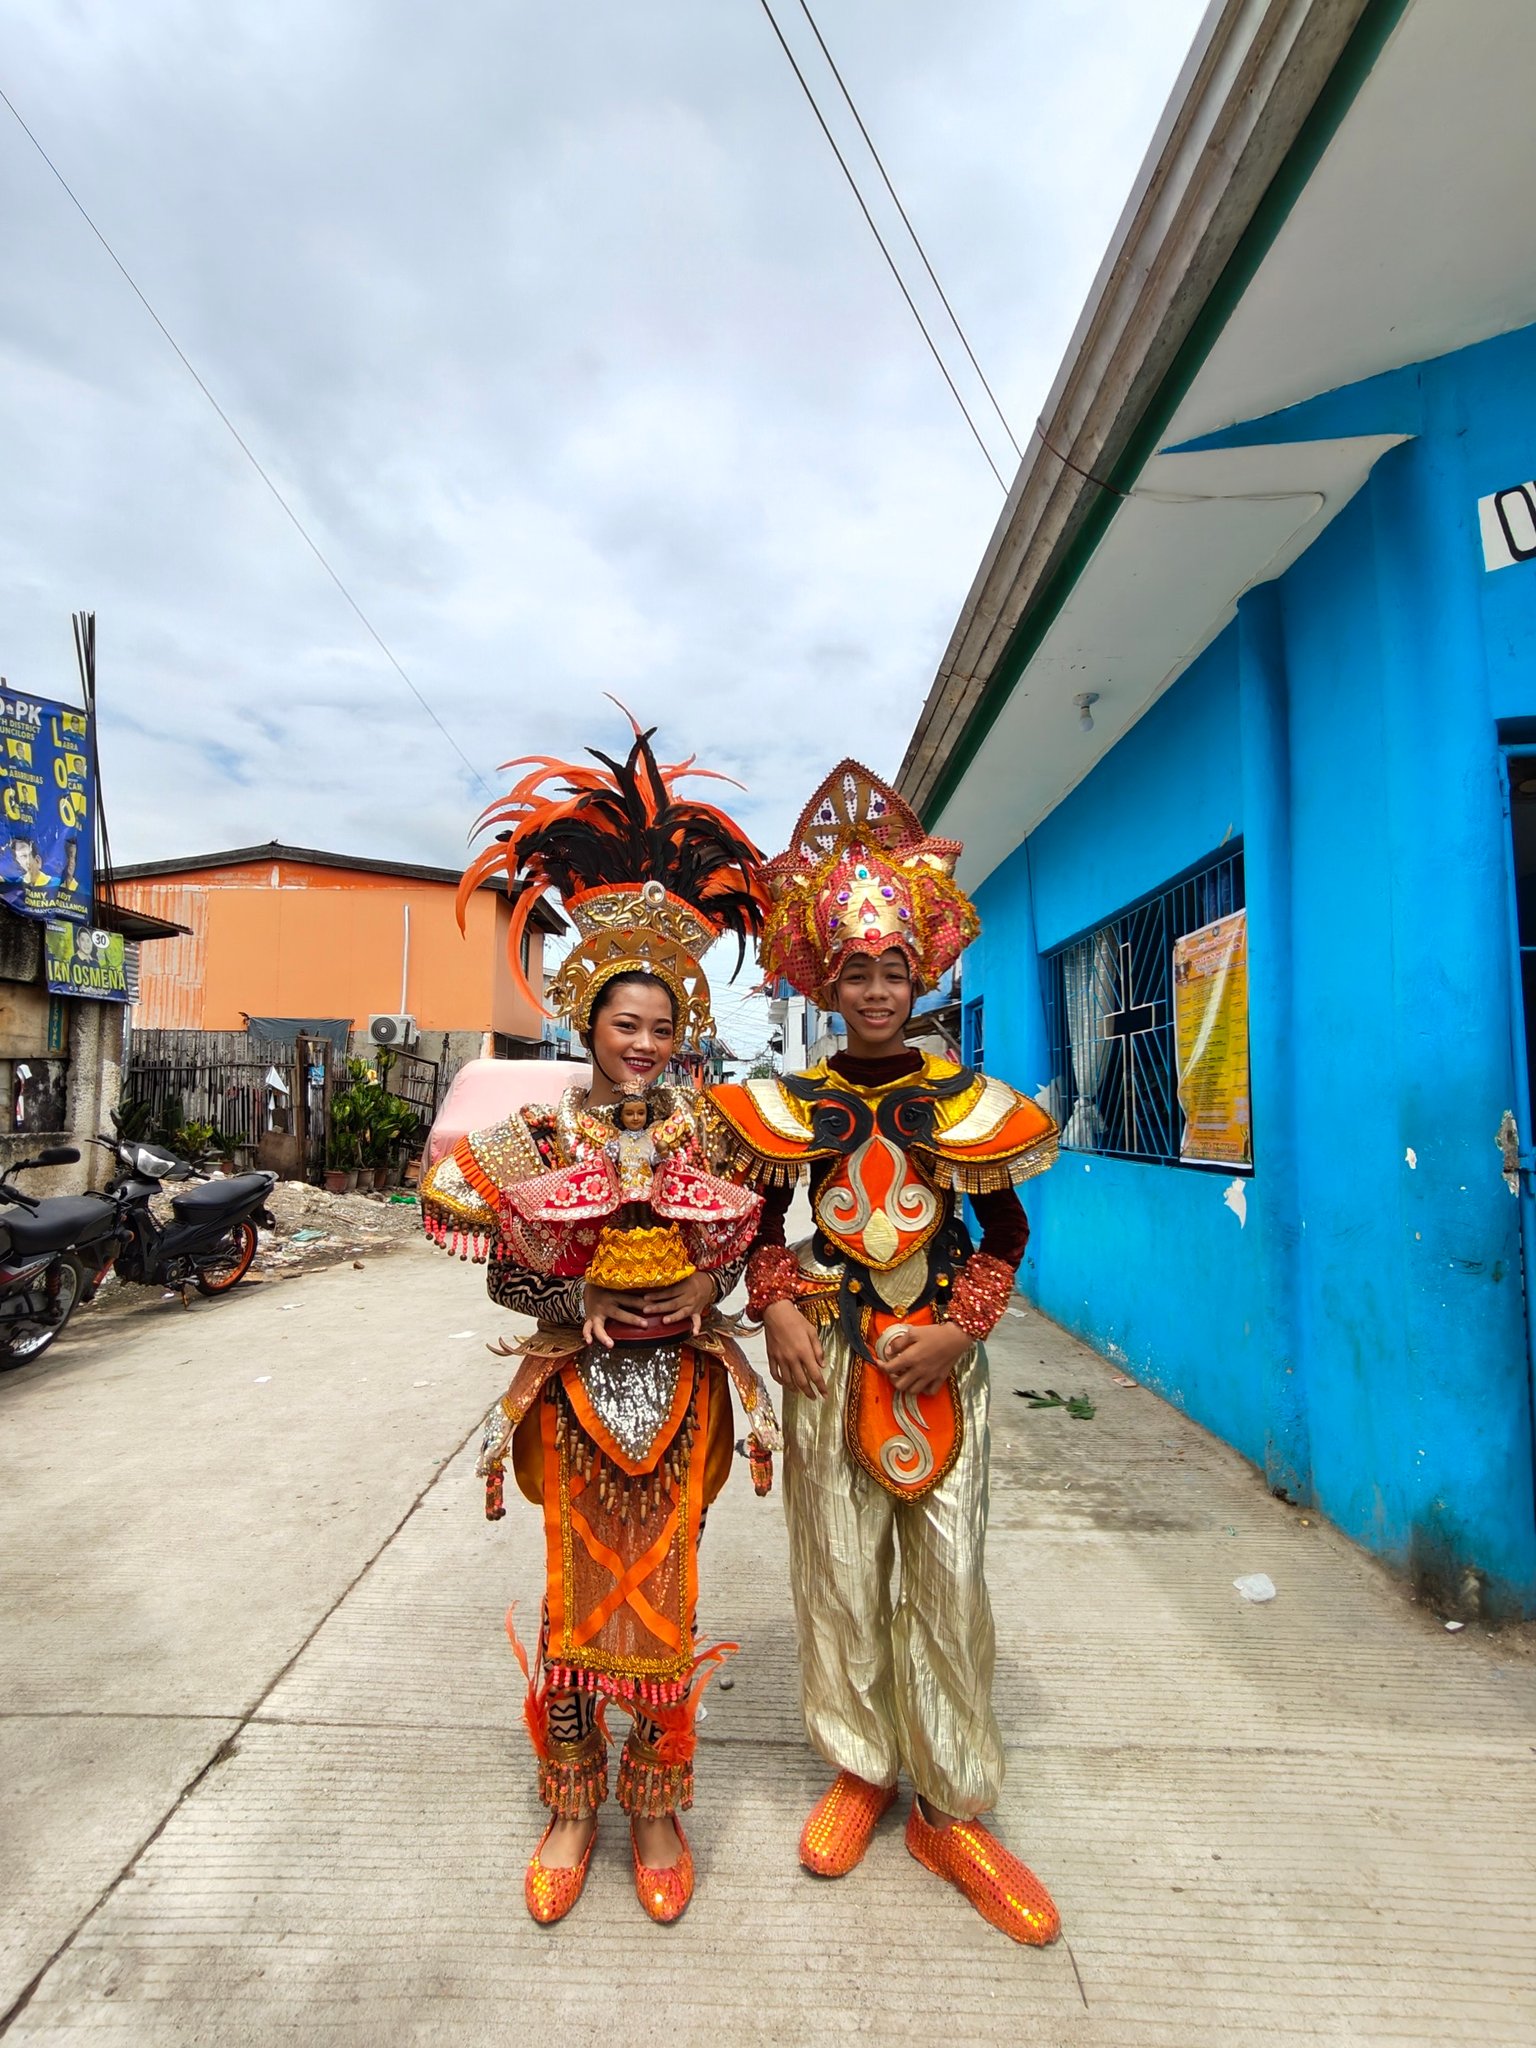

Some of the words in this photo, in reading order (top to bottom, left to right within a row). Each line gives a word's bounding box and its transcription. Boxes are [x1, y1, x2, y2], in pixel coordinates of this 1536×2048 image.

[10, 719, 41, 734] DISTRICT
[94, 933, 107, 946] 30
[73, 964, 127, 991] OSMEÑA
